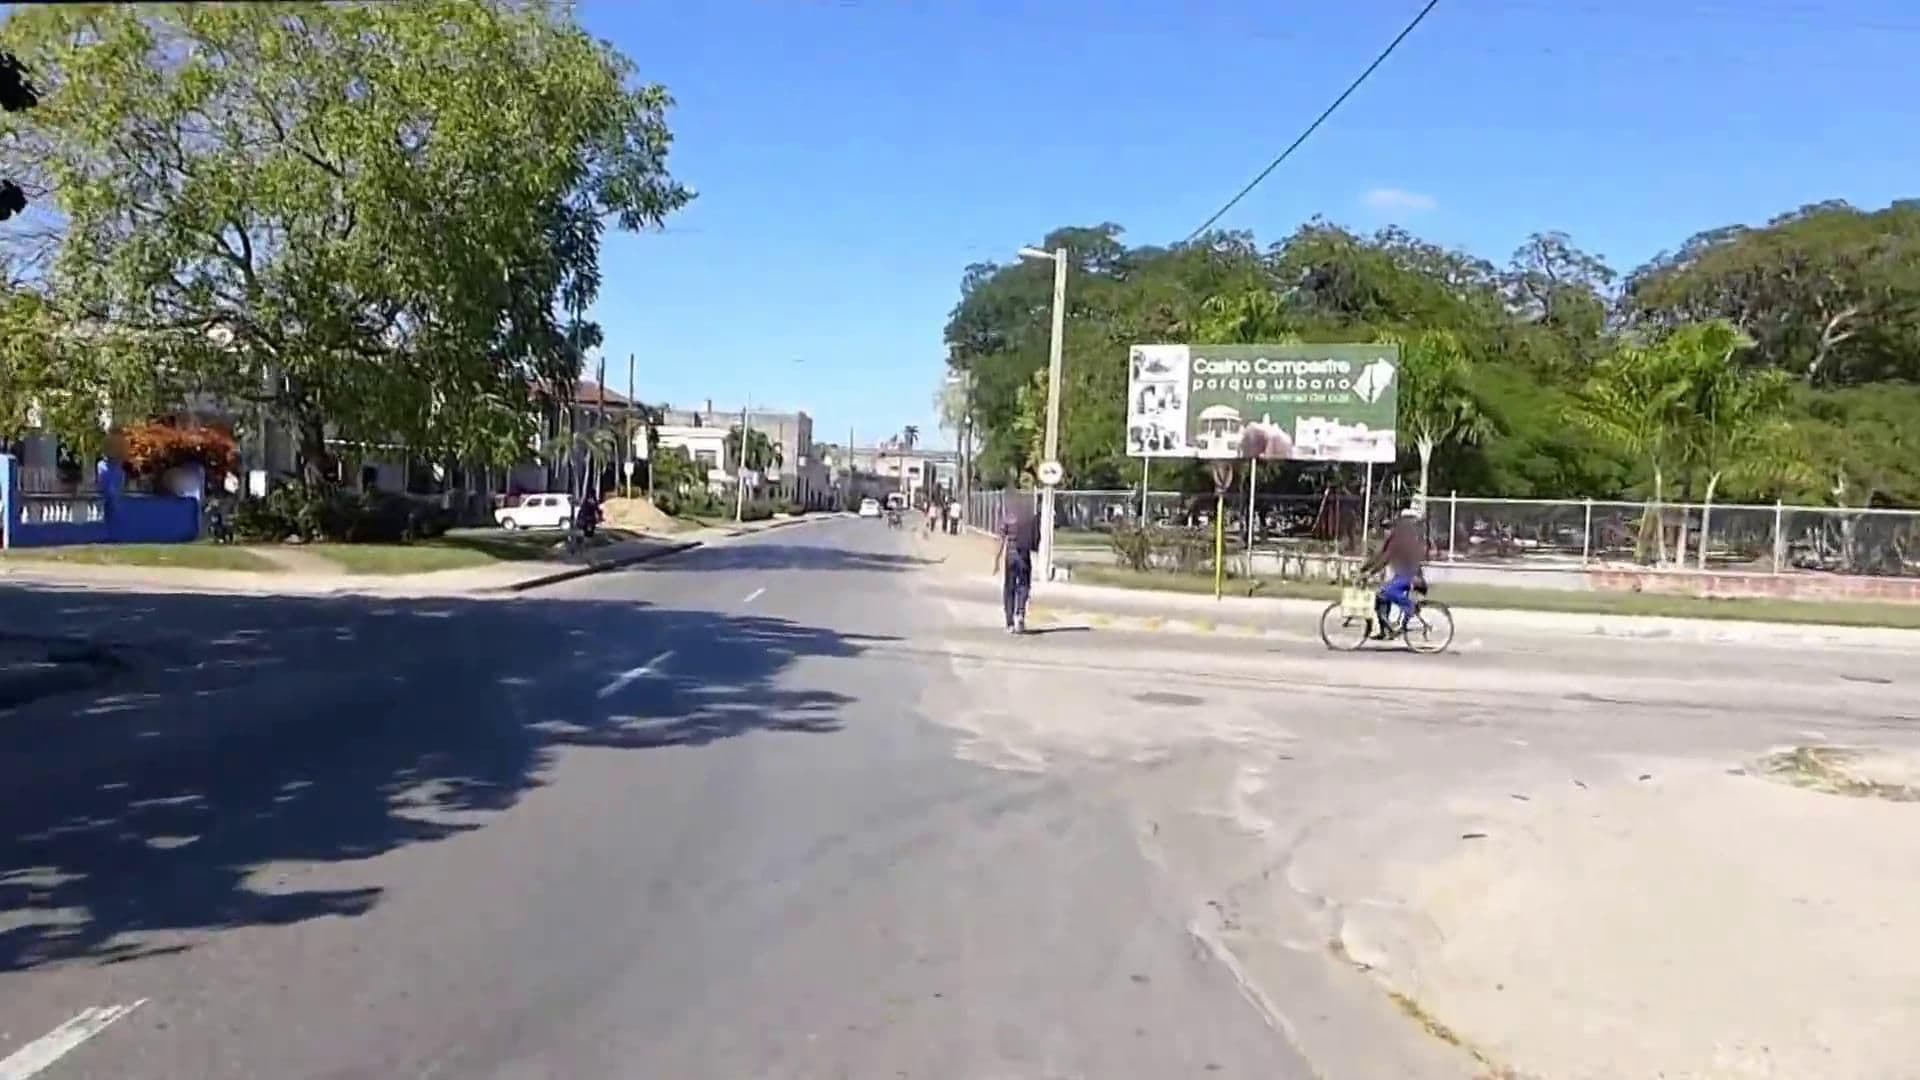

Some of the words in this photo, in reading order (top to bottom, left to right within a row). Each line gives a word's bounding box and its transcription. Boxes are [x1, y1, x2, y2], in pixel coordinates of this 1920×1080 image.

[1193, 357, 1251, 374] Casino
[1254, 357, 1351, 377] Campestre
[1193, 377, 1267, 393] parque
[1273, 375, 1350, 390] urbano
